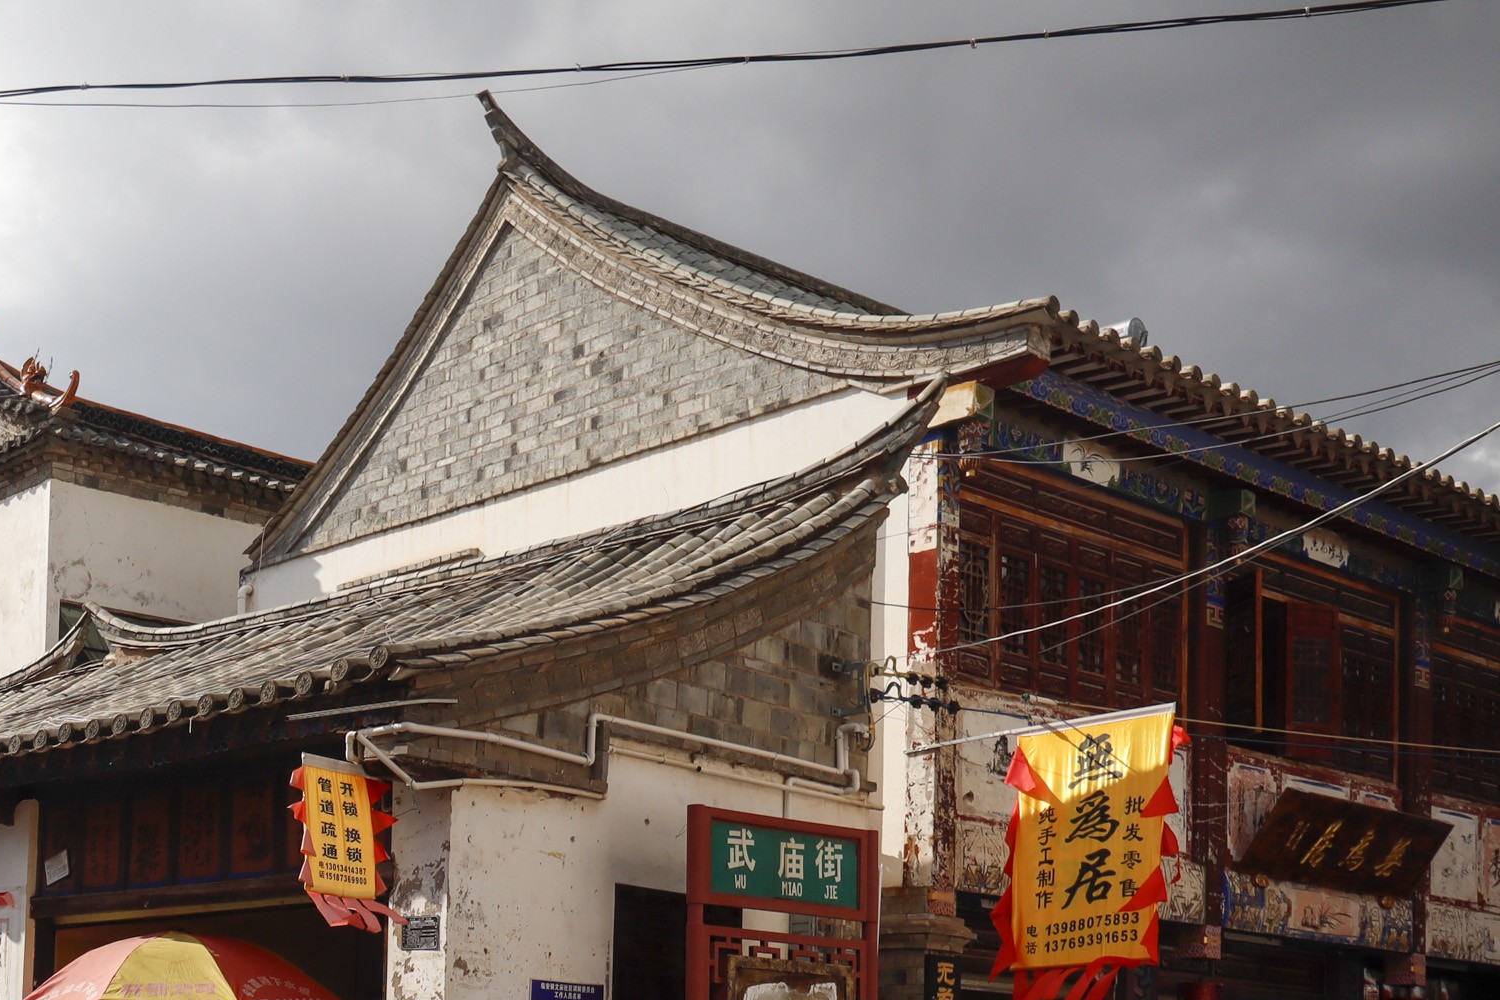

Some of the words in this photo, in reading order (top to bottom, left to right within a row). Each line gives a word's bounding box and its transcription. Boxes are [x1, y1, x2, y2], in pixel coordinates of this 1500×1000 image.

[317, 776, 338, 860] 管道疏通
[726, 827, 844, 883] 武庙街
[1034, 805, 1058, 910] 纯手工制作
[1118, 795, 1147, 898] 批发零售
[734, 873, 748, 890] WU
[781, 880, 803, 897] MIAO
[823, 884, 839, 900] JIE
[1043, 929, 1139, 954] 13769391653
[1045, 911, 1140, 937] 13988075893
